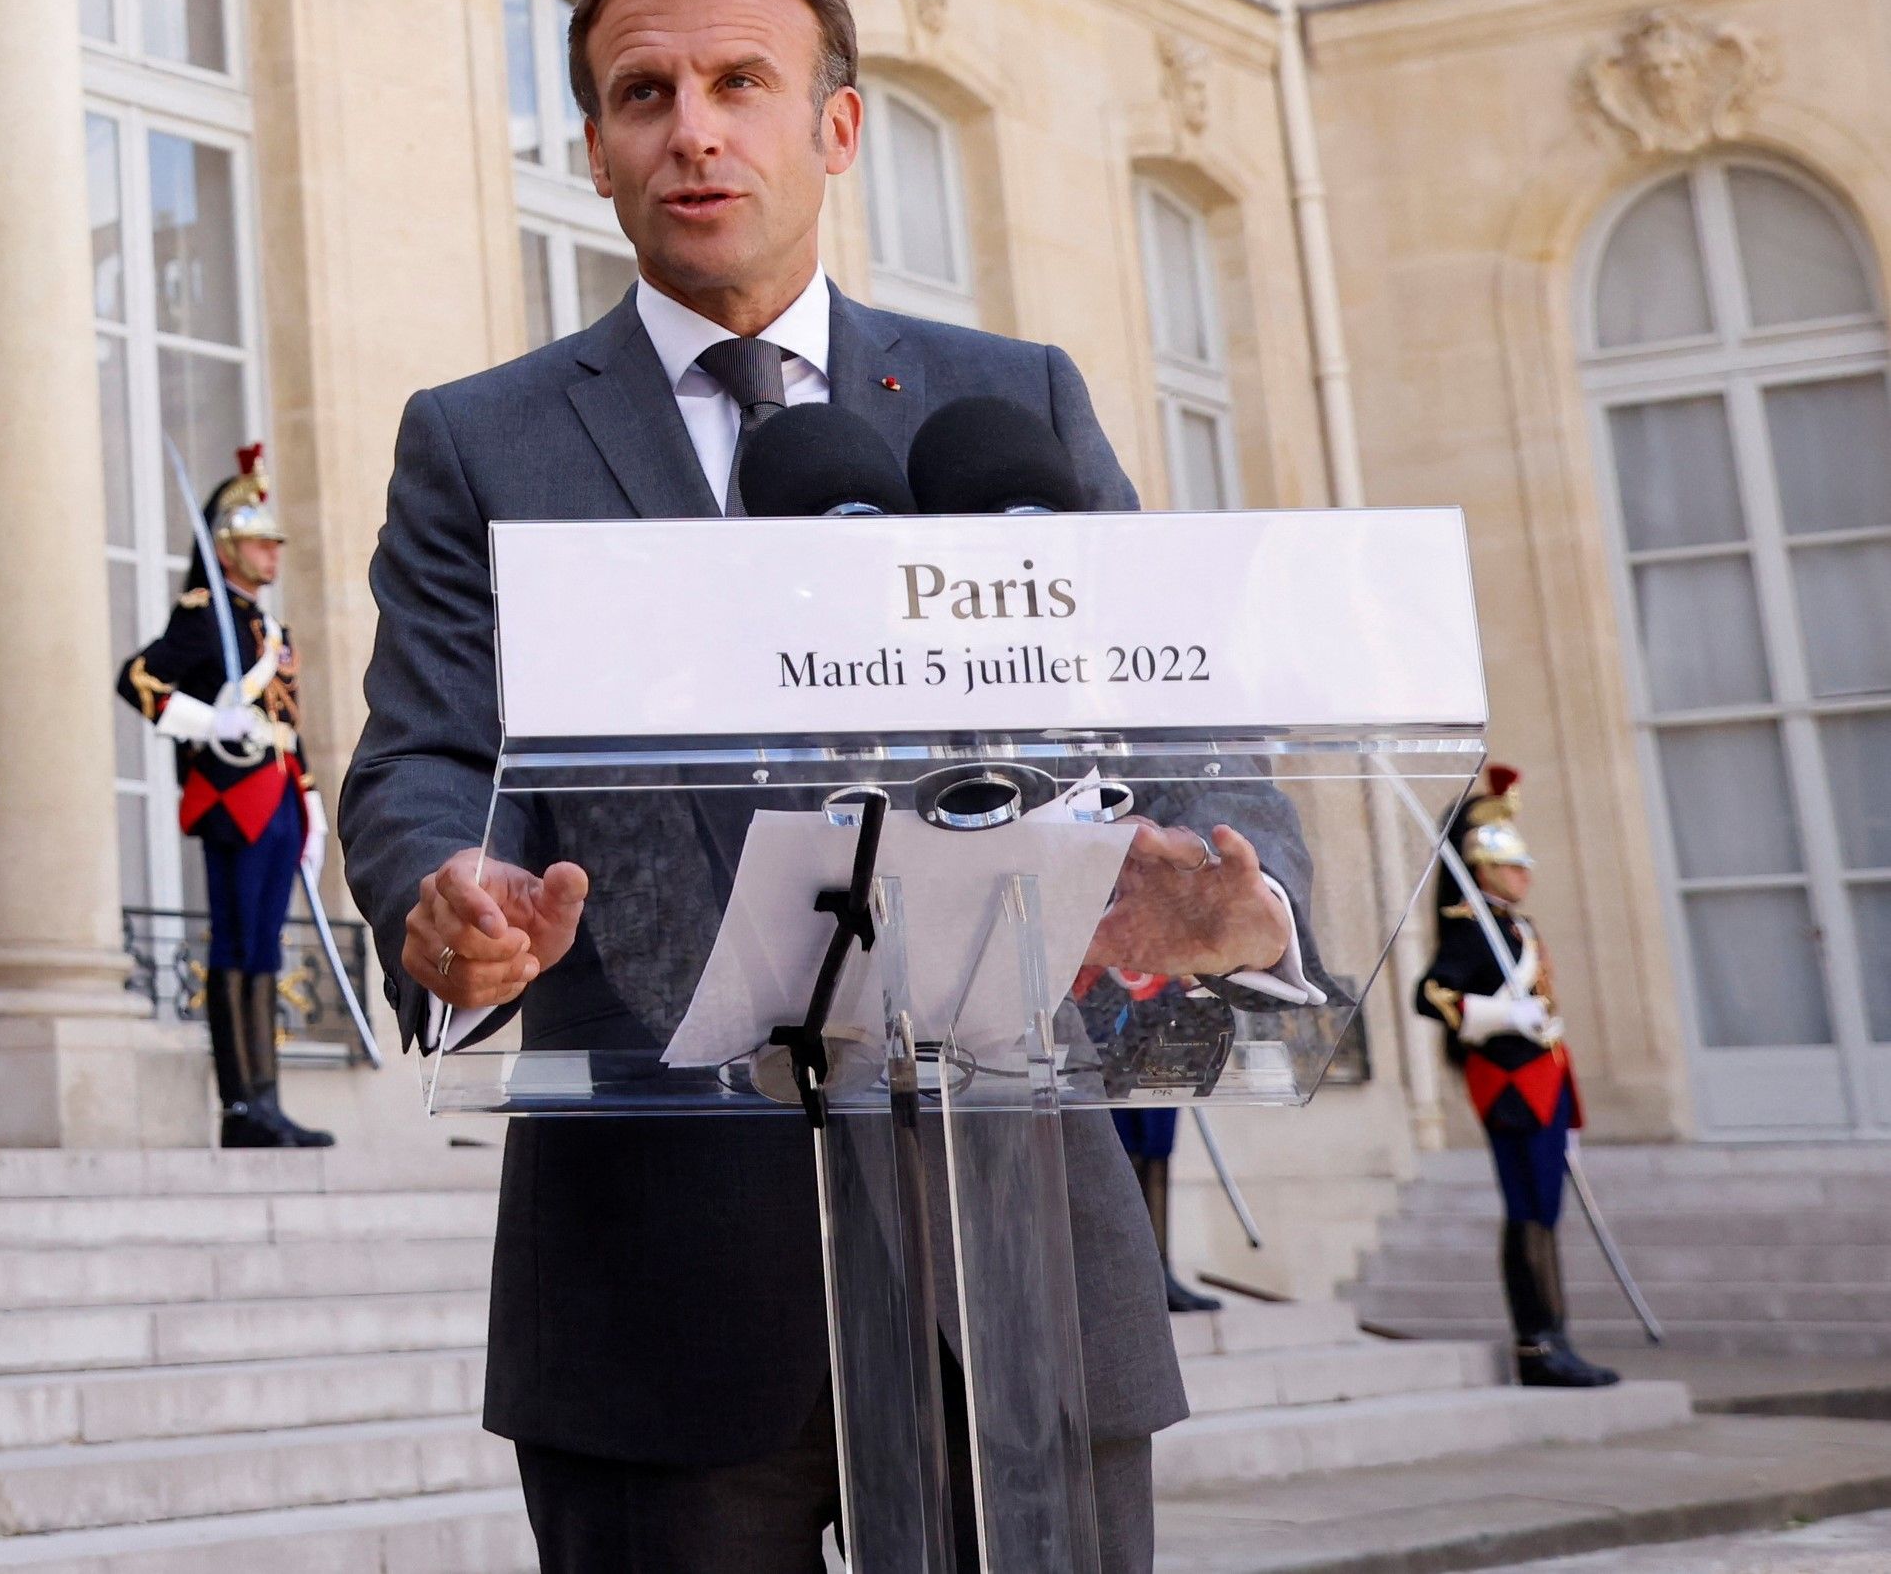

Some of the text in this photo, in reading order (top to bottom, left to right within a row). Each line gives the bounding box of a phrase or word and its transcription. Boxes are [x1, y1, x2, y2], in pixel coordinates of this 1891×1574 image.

[898, 559, 1077, 620] Paris
[776, 645, 1211, 695] Mardi 5 juillet 2022
